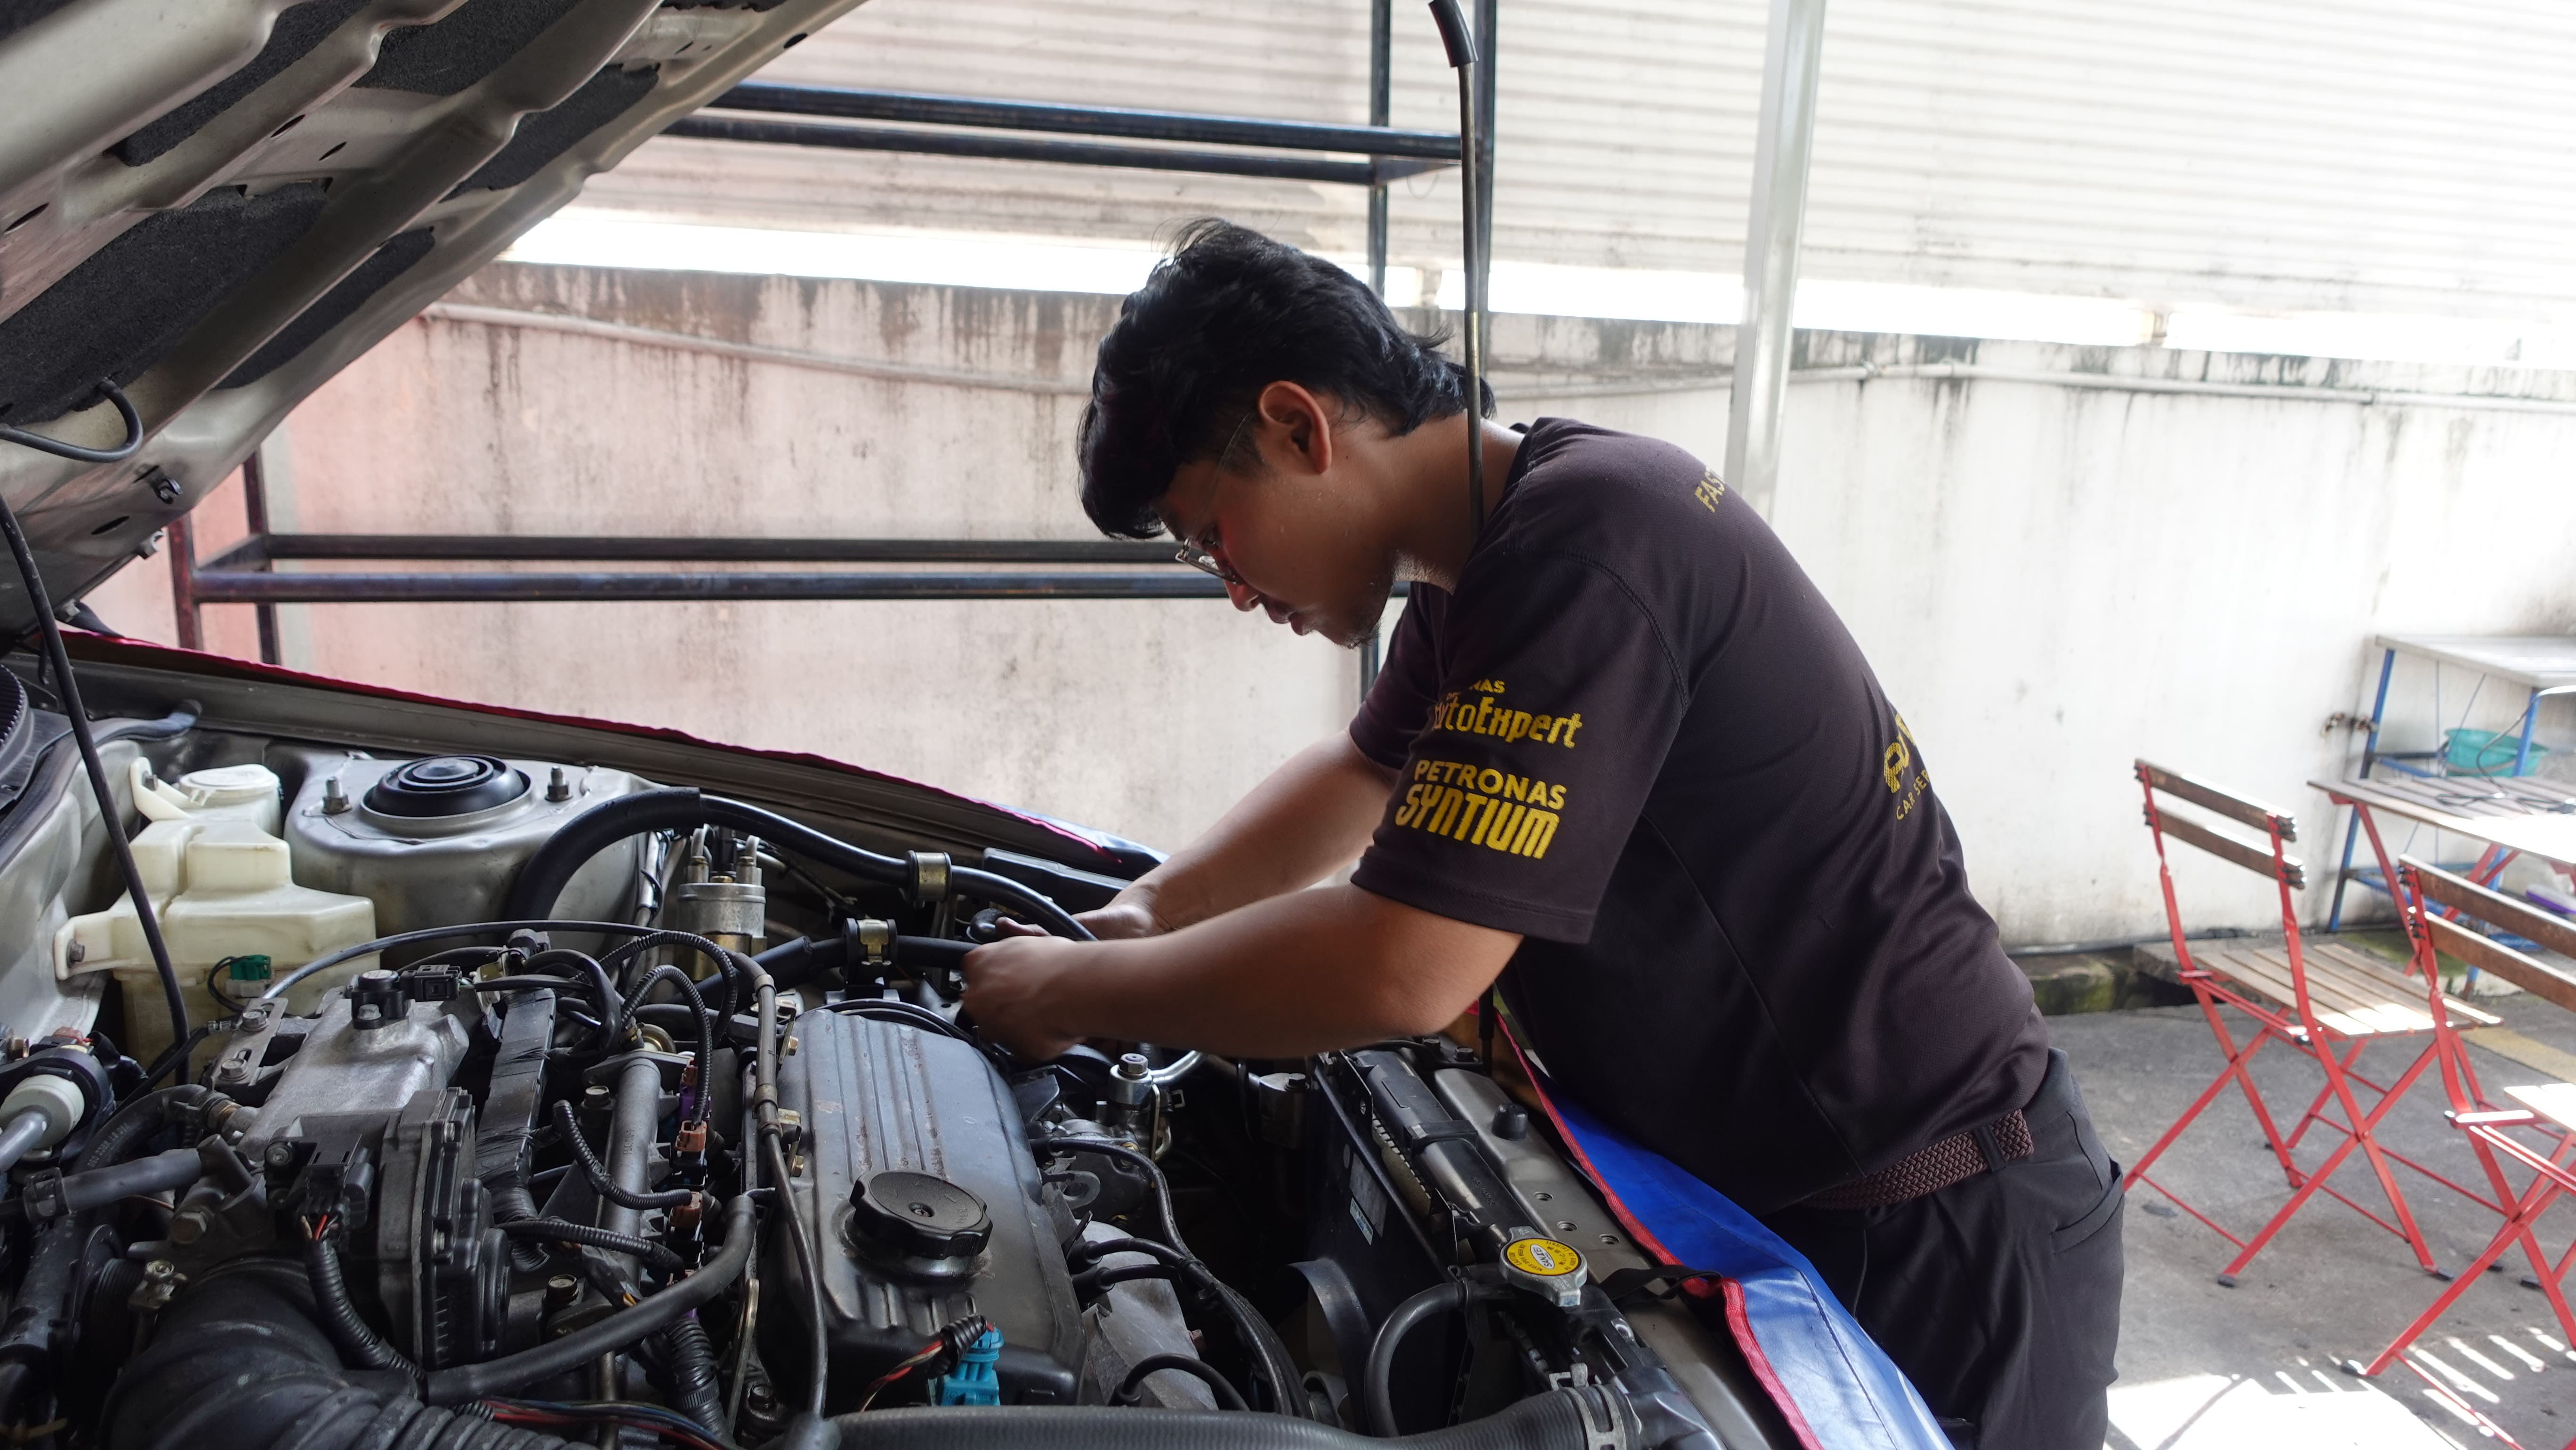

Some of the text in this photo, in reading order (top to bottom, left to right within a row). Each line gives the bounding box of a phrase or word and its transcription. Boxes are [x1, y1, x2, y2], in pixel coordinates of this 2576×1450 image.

[1414, 759, 1568, 811] PETRONAS
[1896, 791, 1916, 820] CAR
[1395, 783, 1561, 860] SYNTIUM
